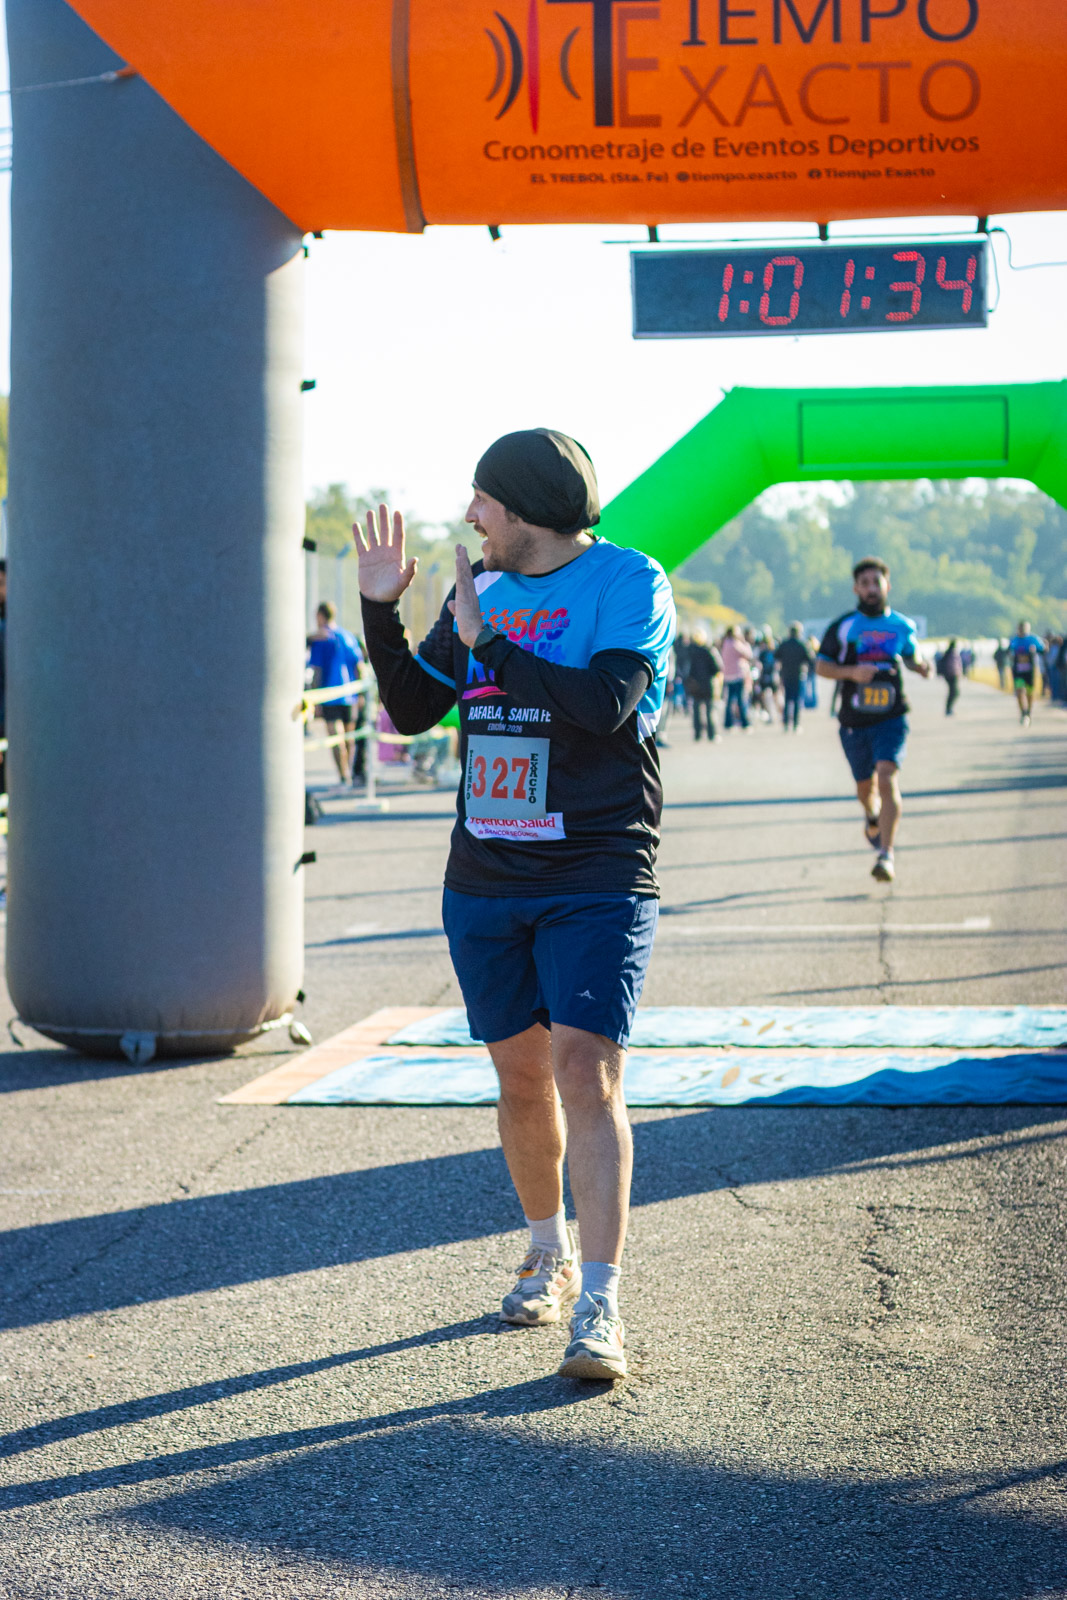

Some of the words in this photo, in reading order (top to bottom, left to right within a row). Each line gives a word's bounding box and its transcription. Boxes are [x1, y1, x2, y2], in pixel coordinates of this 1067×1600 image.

[483, 138, 665, 164] Cronometraje
[672, 136, 706, 158] de
[713, 136, 820, 158] Eventos
[828, 133, 980, 159] Deportivos
[530, 174, 547, 184] EL
[824, 167, 882, 180] Tiempo
[885, 166, 936, 178] Exacto
[468, 705, 504, 721] RAFAELA,
[508, 708, 539, 722] SANTA
[507, 724, 523, 733] 2026
[472, 755, 530, 800] 327
[529, 753, 538, 804] EXACTO
